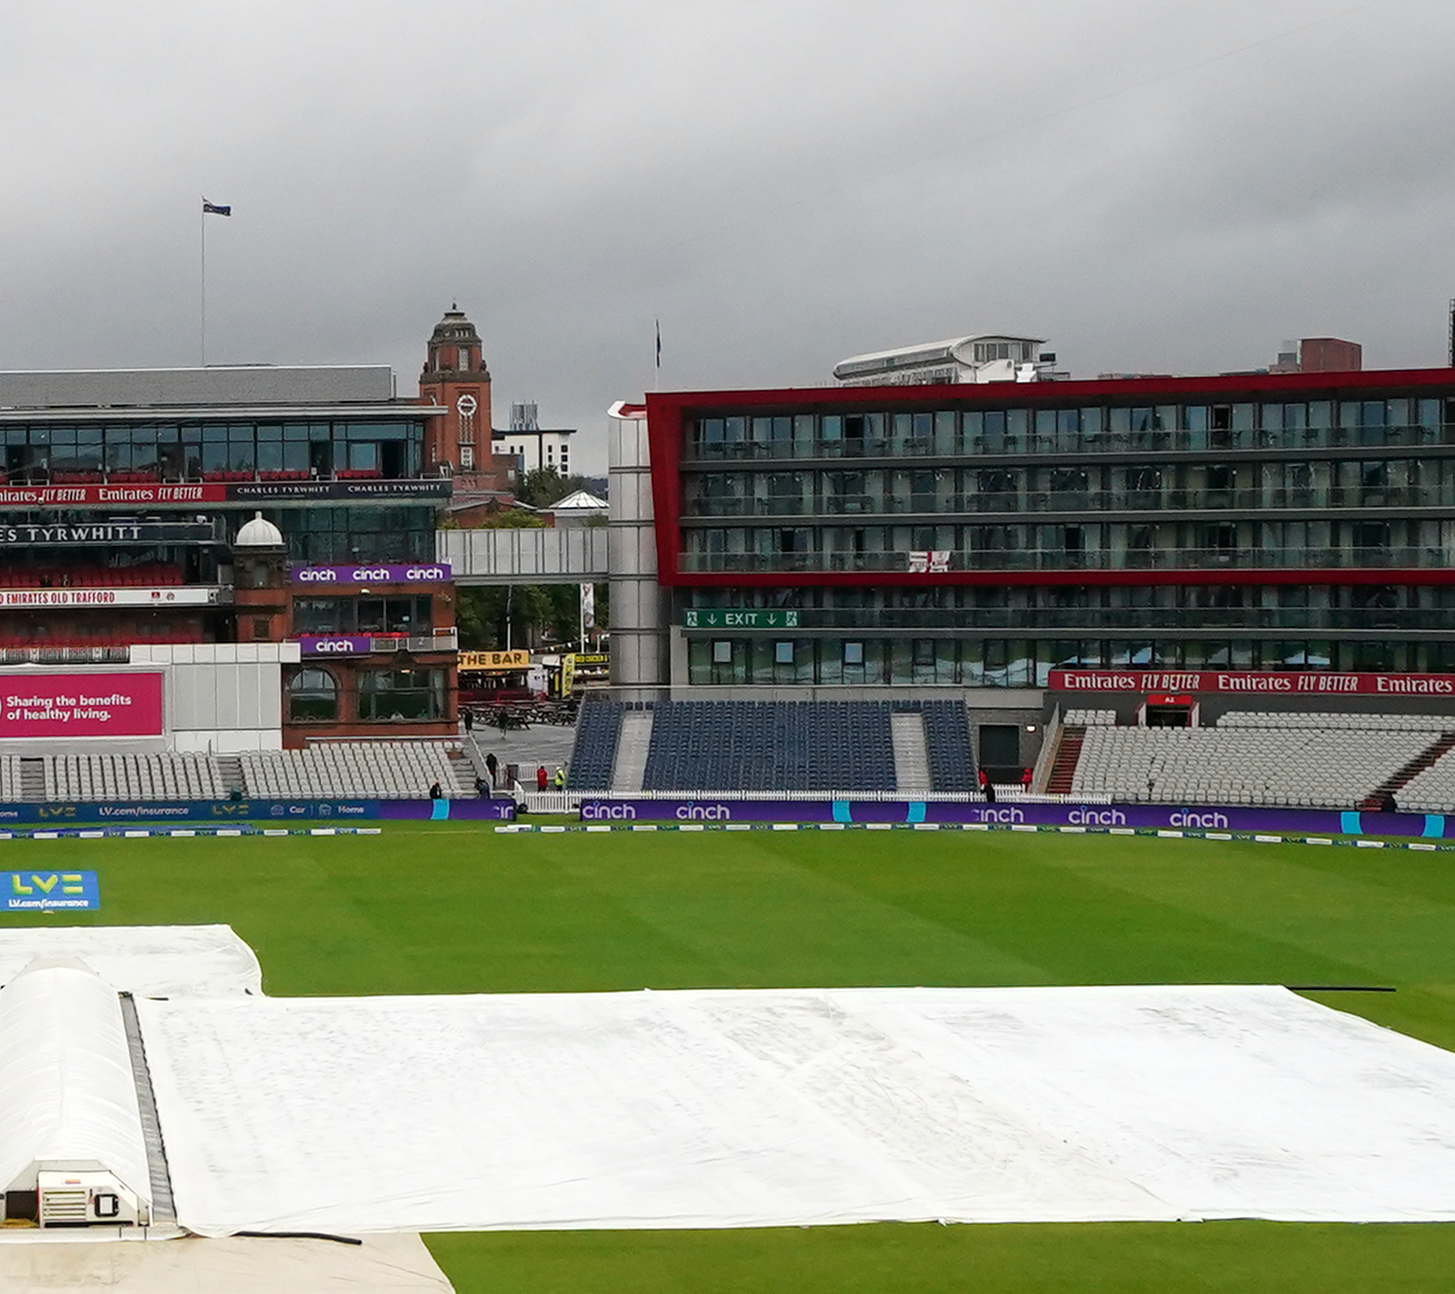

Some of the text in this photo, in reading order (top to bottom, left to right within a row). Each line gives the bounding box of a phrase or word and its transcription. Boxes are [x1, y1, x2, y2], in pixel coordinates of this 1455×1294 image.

[57, 489, 86, 501] BETTER
[99, 486, 203, 501] Emirates FLY BETTER
[27, 527, 141, 541] TYRWHITT
[299, 568, 336, 581] cinch
[352, 567, 389, 580] cinch
[406, 567, 442, 580] cinch
[7, 594, 48, 604] EMIRATES
[51, 593, 69, 603] OLD
[71, 592, 115, 603] TRAFFORD
[725, 613, 758, 625] EXIT
[316, 638, 353, 652] cinch
[492, 653, 522, 665] BAR
[1064, 673, 1200, 690] Emirates FLY BETTER
[1218, 675, 1358, 691] Emirates FLY BETTER
[1377, 677, 1453, 693] Emirates
[7, 695, 131, 709] Sharing the benefits
[7, 708, 111, 723] of healthy living.
[99, 805, 189, 817] LV.com/insurance
[289, 805, 364, 814] Car Home
[582, 801, 636, 820] cinch
[676, 801, 730, 820] cinch
[1068, 806, 1126, 826] cinch
[1169, 808, 1228, 828] cinch
[12, 875, 83, 895] LV=
[8, 898, 89, 910] LV.com/insurance
